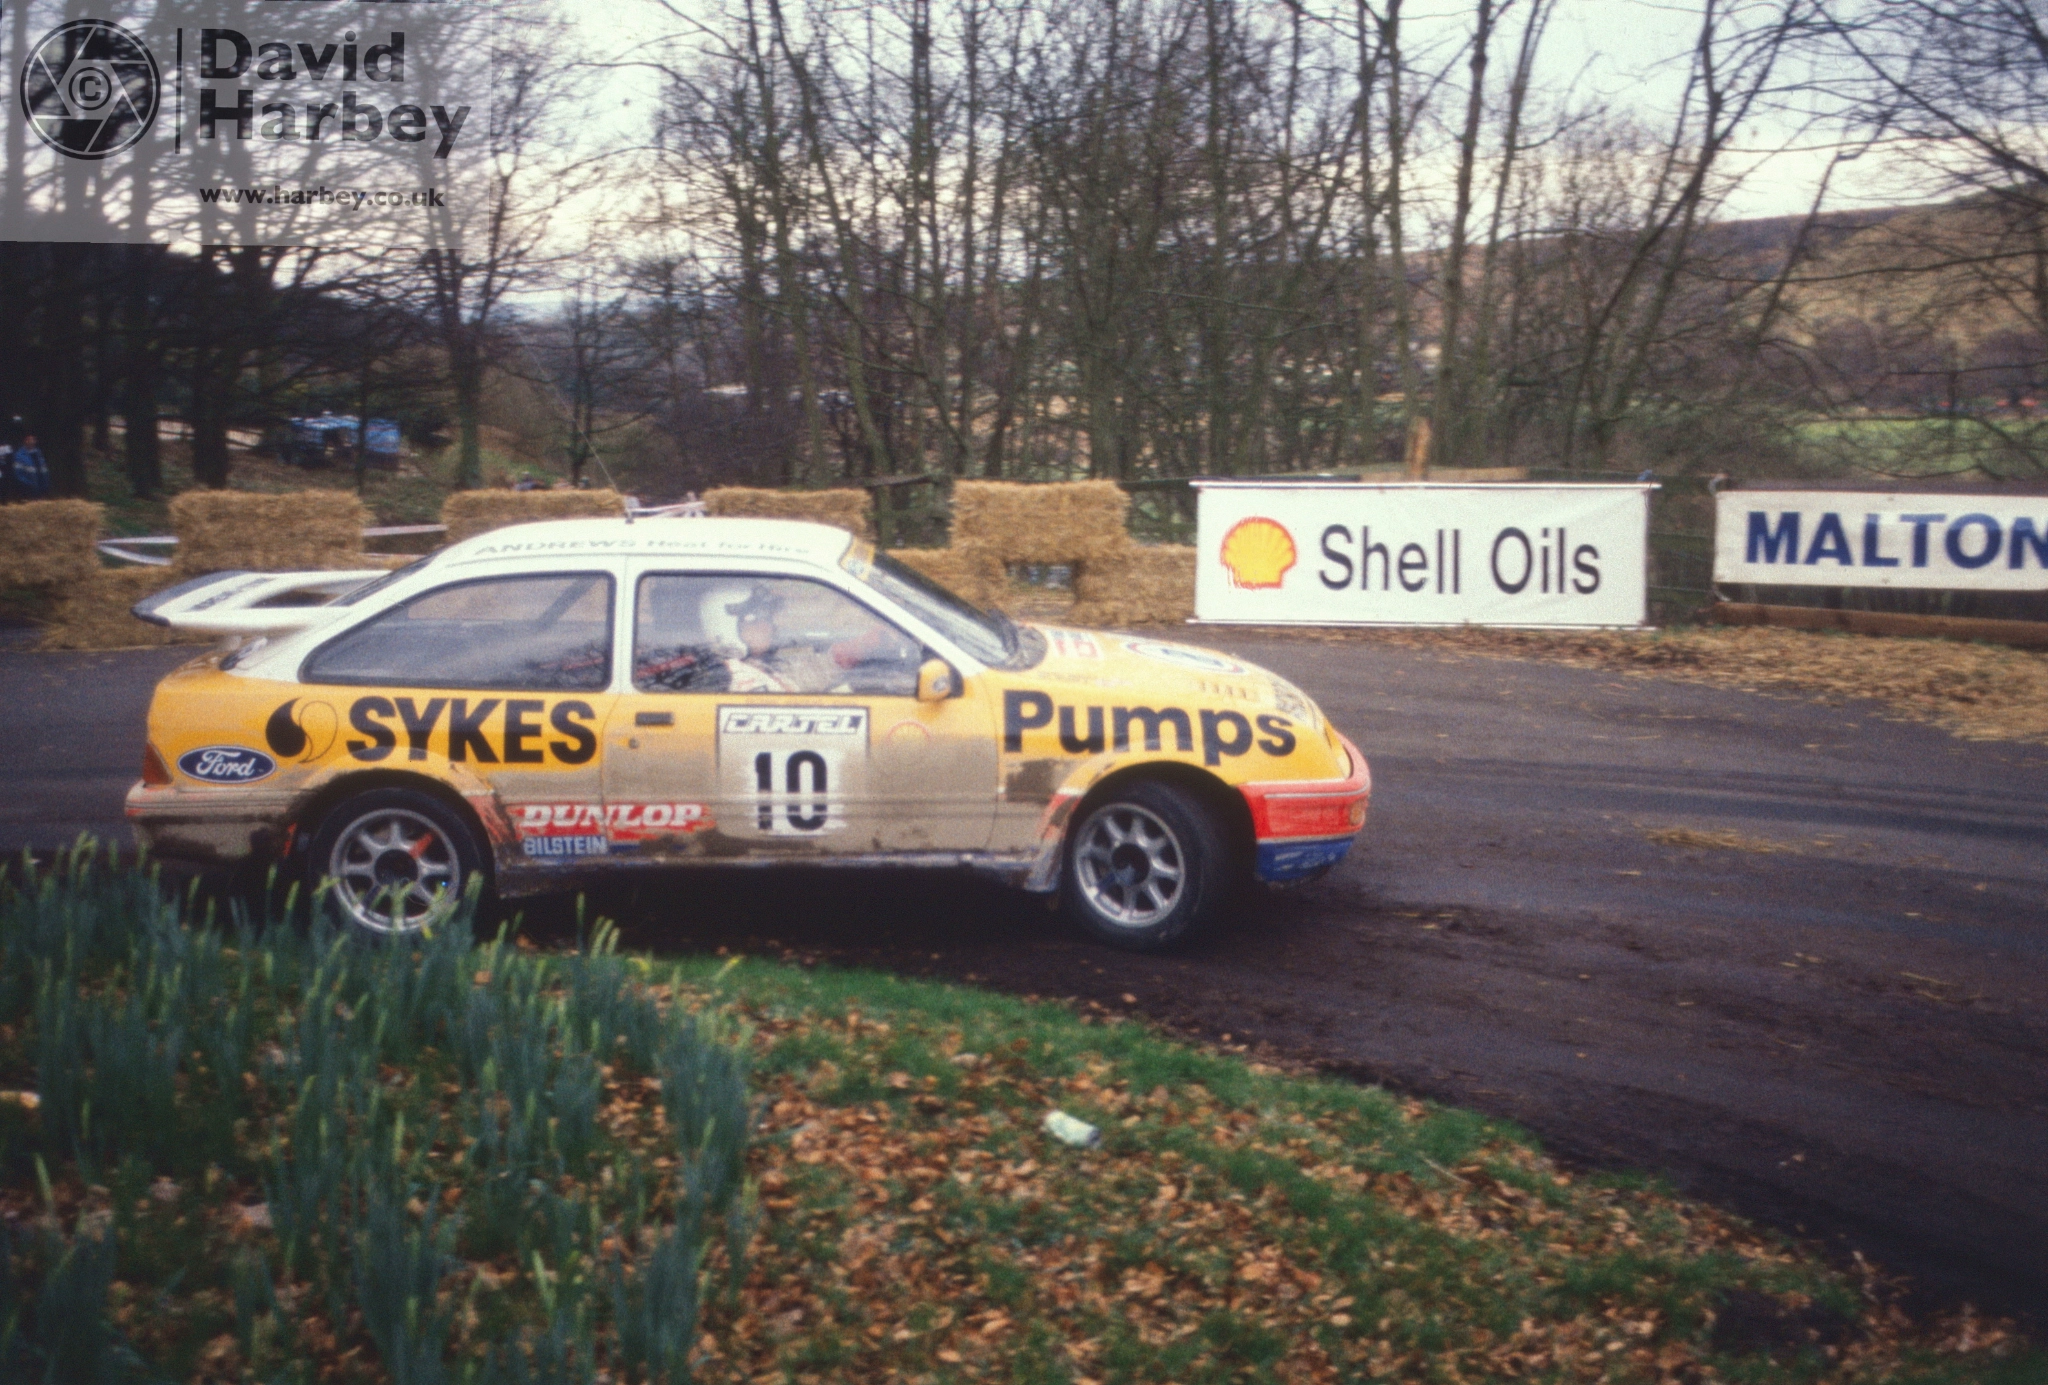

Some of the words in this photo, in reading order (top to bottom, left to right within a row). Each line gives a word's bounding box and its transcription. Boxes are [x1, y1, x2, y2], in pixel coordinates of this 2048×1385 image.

[1319, 524, 1460, 594] Shell
[1491, 527, 1600, 594] Oils
[1746, 511, 2048, 569] MALTON
[346, 696, 596, 763] SYKES
[723, 713, 863, 734] CARTEL
[1003, 690, 1296, 766] Pumps
[196, 750, 256, 776] Ford
[754, 750, 828, 831] 10
[519, 804, 702, 827] DUNLOP
[523, 836, 609, 855] BILSTEIN
